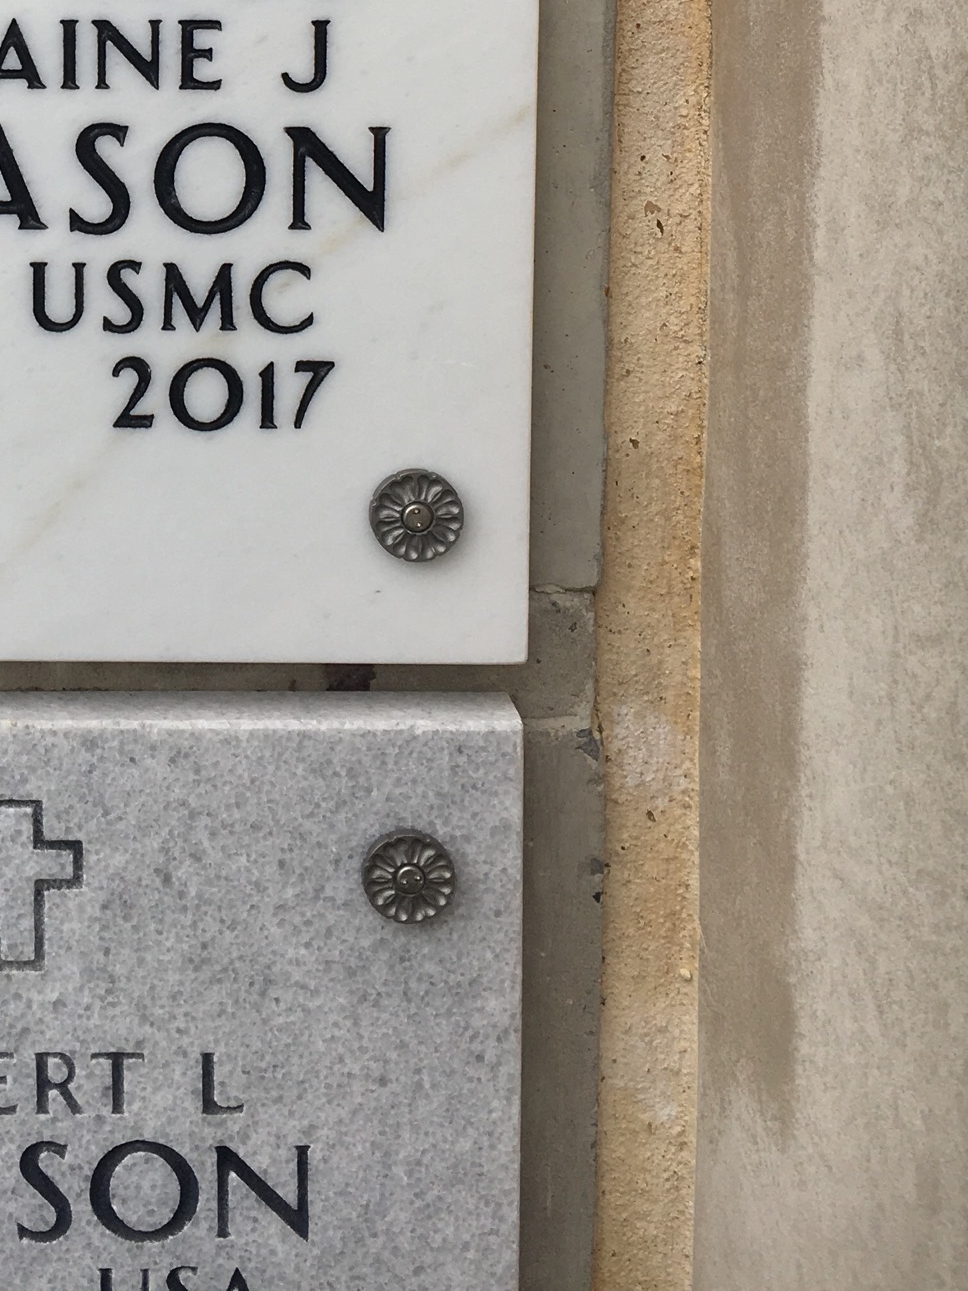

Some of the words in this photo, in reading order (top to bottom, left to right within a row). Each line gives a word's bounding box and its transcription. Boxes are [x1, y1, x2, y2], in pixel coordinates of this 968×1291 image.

[279, 18, 332, 95] J
[28, 258, 315, 336] USMC
[111, 354, 337, 433] 2017
[199, 1051, 245, 1117] L
